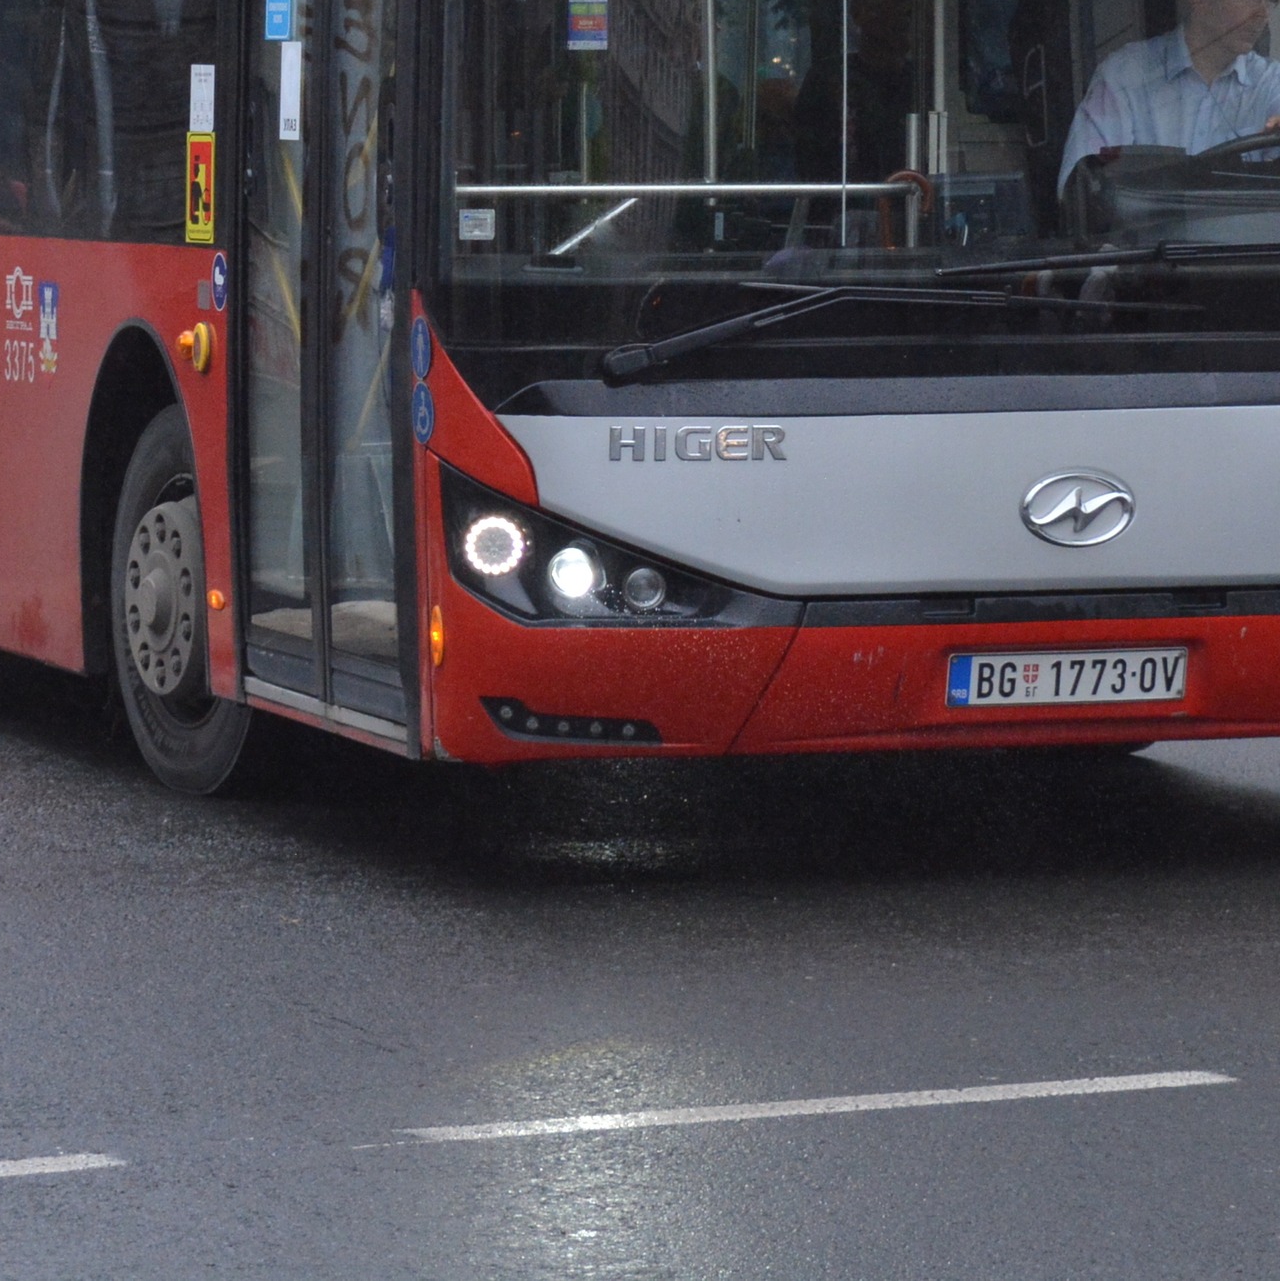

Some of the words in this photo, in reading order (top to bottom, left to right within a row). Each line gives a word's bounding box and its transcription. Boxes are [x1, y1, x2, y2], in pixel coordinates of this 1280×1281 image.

[4, 339, 35, 383] 3375
[609, 424, 787, 462] HIGER
[976, 661, 1018, 699] BG
